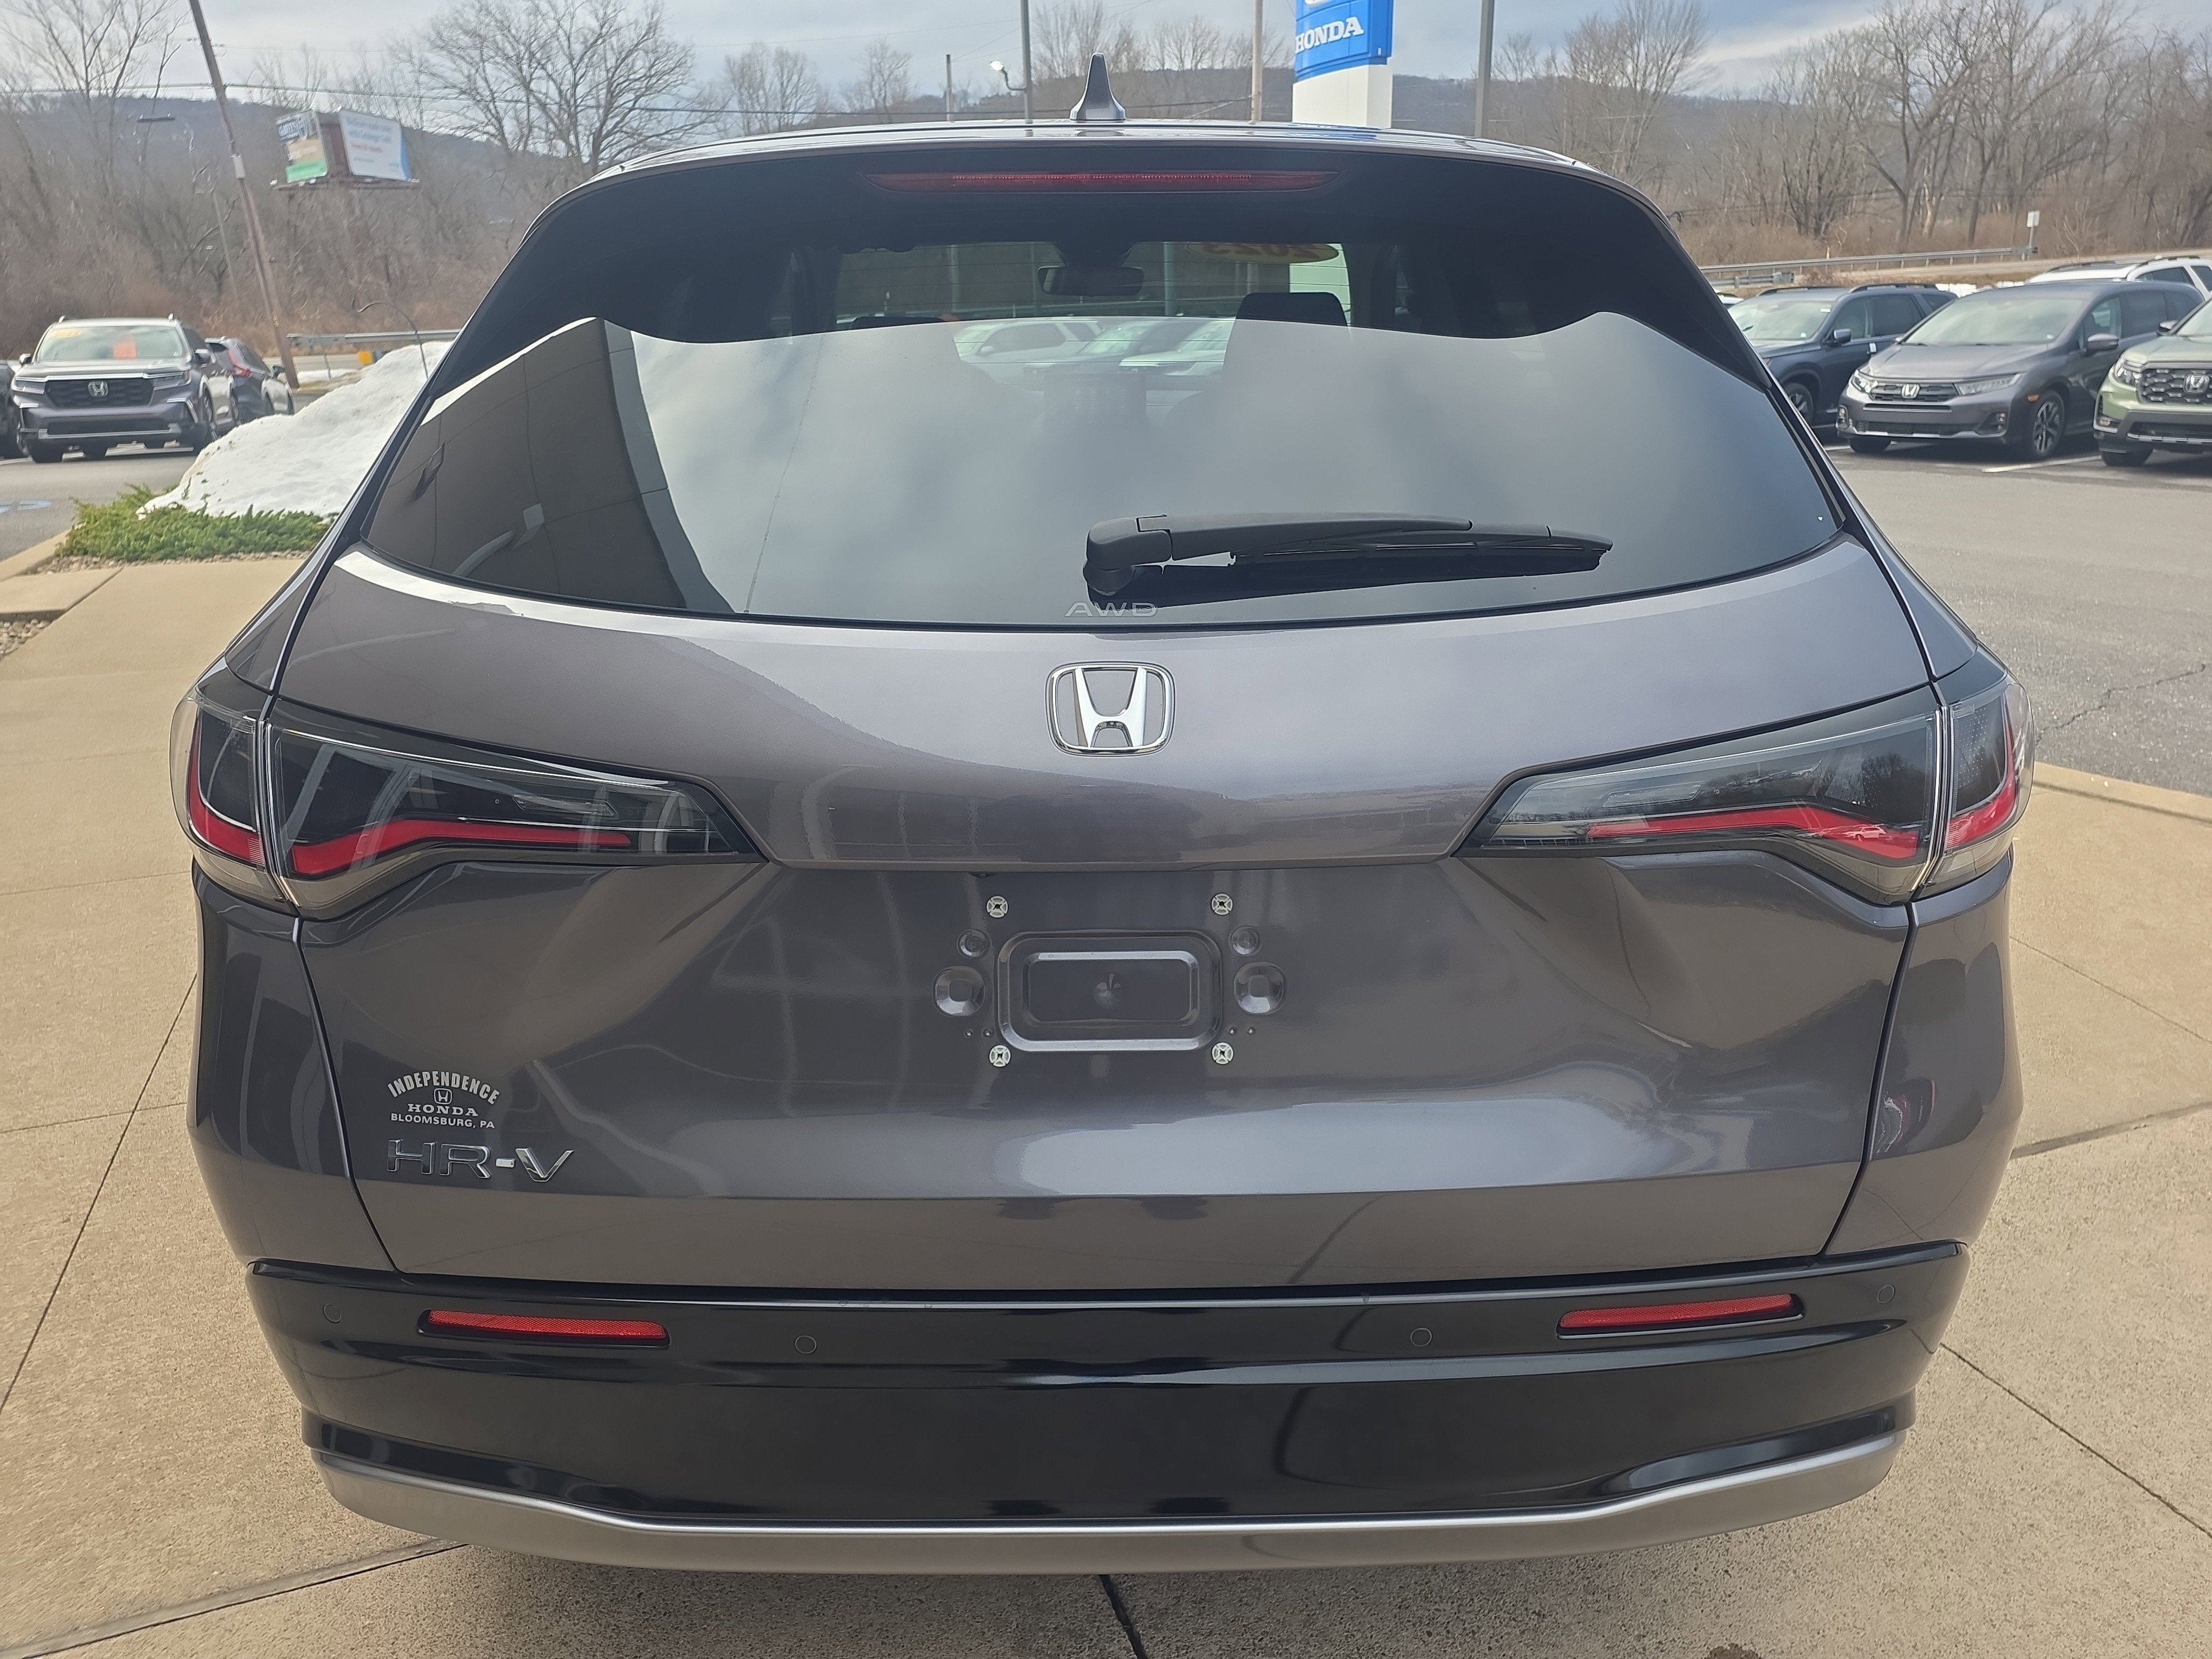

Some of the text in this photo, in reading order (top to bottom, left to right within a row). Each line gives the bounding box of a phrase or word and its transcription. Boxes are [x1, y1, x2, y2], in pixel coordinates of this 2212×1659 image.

[1295, 16, 1365, 54] HONDA
[1064, 602, 1158, 618] AWD
[387, 1070, 500, 1105] INDEPENDENCE
[390, 1113, 495, 1129] BLOOMSBURG, PA
[407, 1103, 479, 1117] HONDA
[387, 1139, 575, 1182] HR-V
